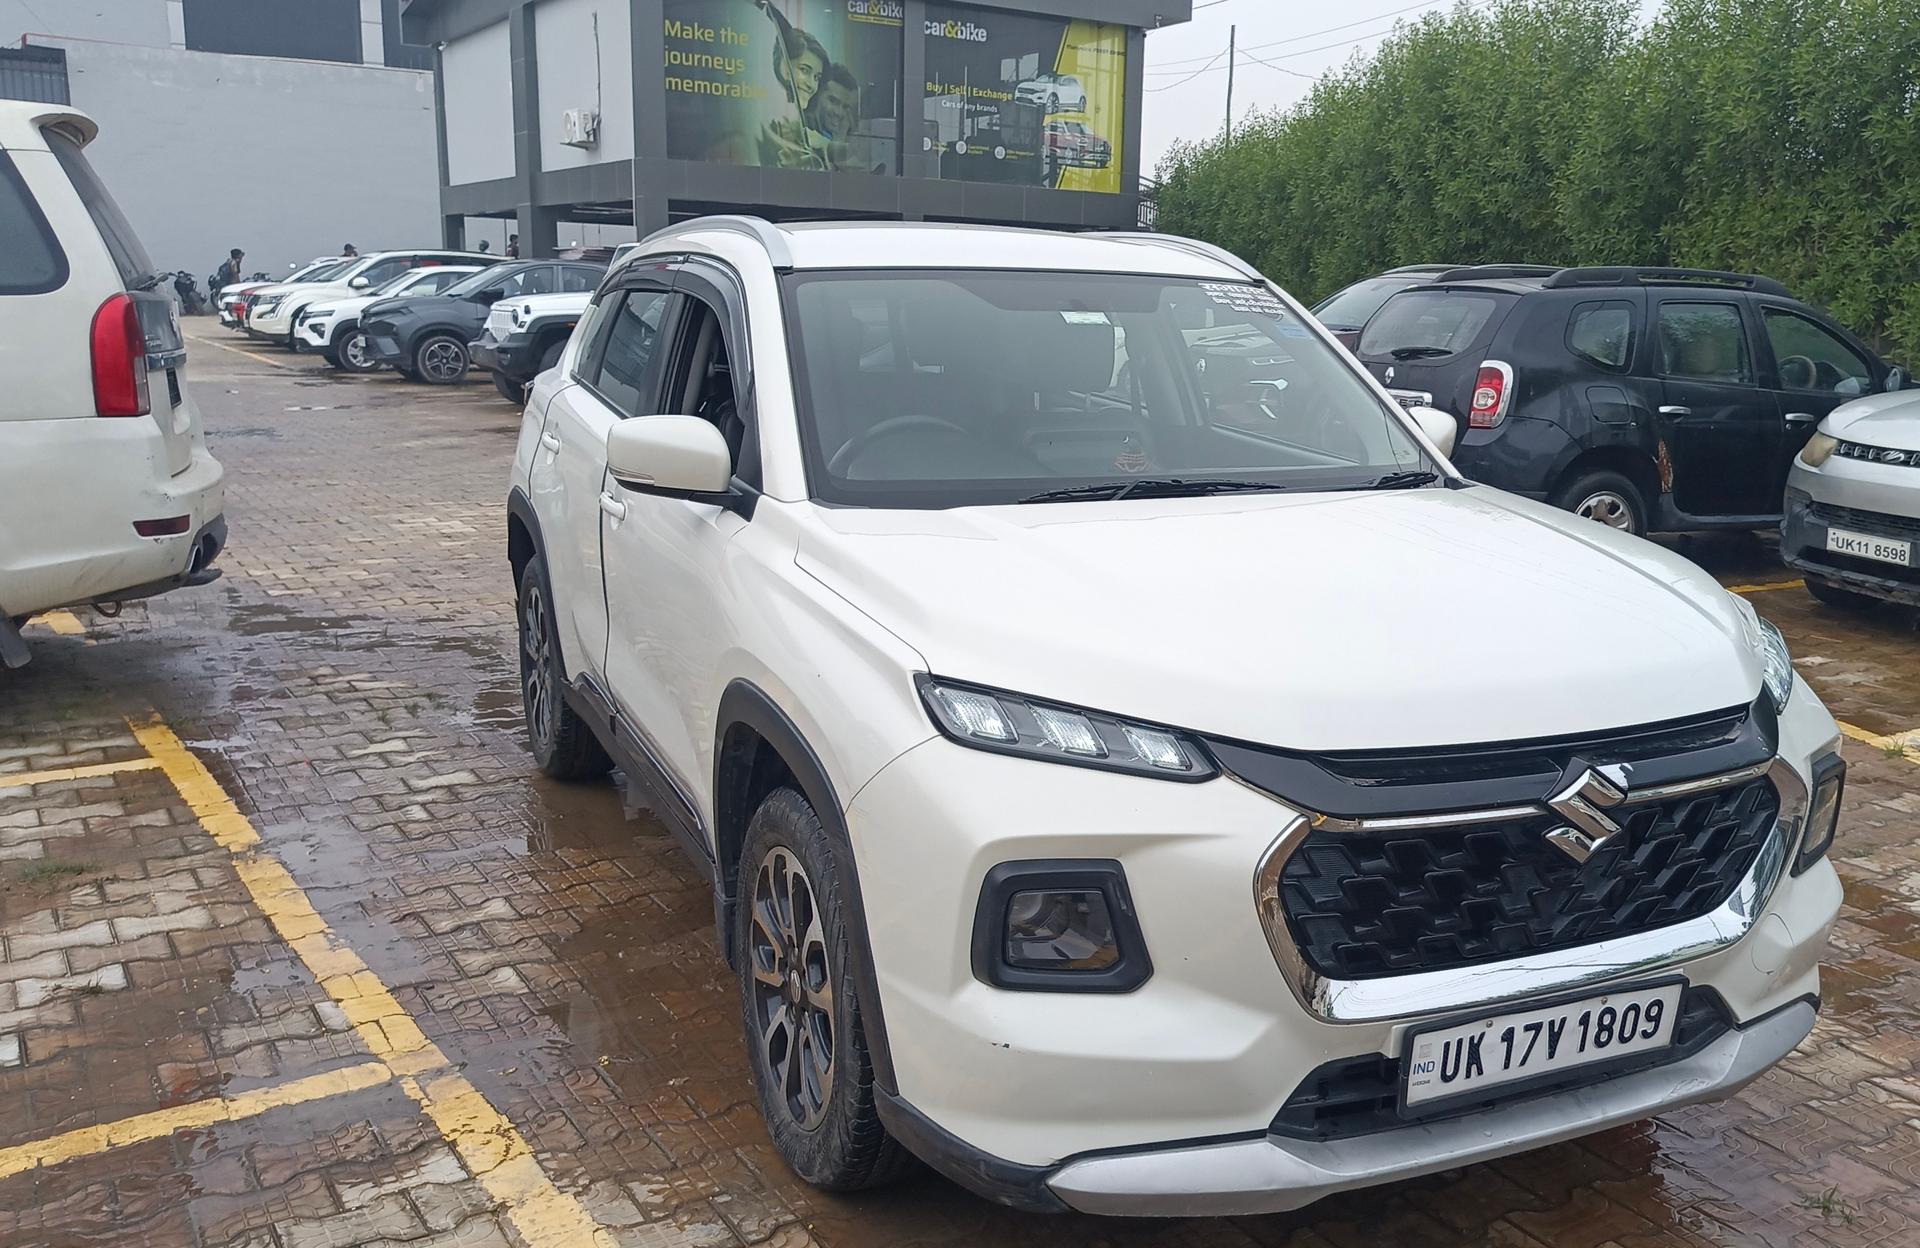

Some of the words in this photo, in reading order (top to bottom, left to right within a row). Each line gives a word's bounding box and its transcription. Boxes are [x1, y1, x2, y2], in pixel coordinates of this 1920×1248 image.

[664, 19, 715, 43] Make
[719, 27, 749, 46] the
[924, 20, 987, 42] car&bike
[664, 45, 746, 76] journeys
[665, 75, 768, 98] memorab
[926, 82, 944, 95] Buy
[949, 84, 967, 96] Sell
[972, 87, 1013, 102] Exchange
[941, 100, 956, 109] Cars
[956, 101, 964, 109] of
[976, 103, 998, 113] brands
[1836, 536, 1869, 554] UK11
[1874, 544, 1907, 562] 8598
[1440, 1030, 1487, 1083] UK
[1578, 998, 1664, 1053] 1809
[1413, 1060, 1436, 1075] IND
